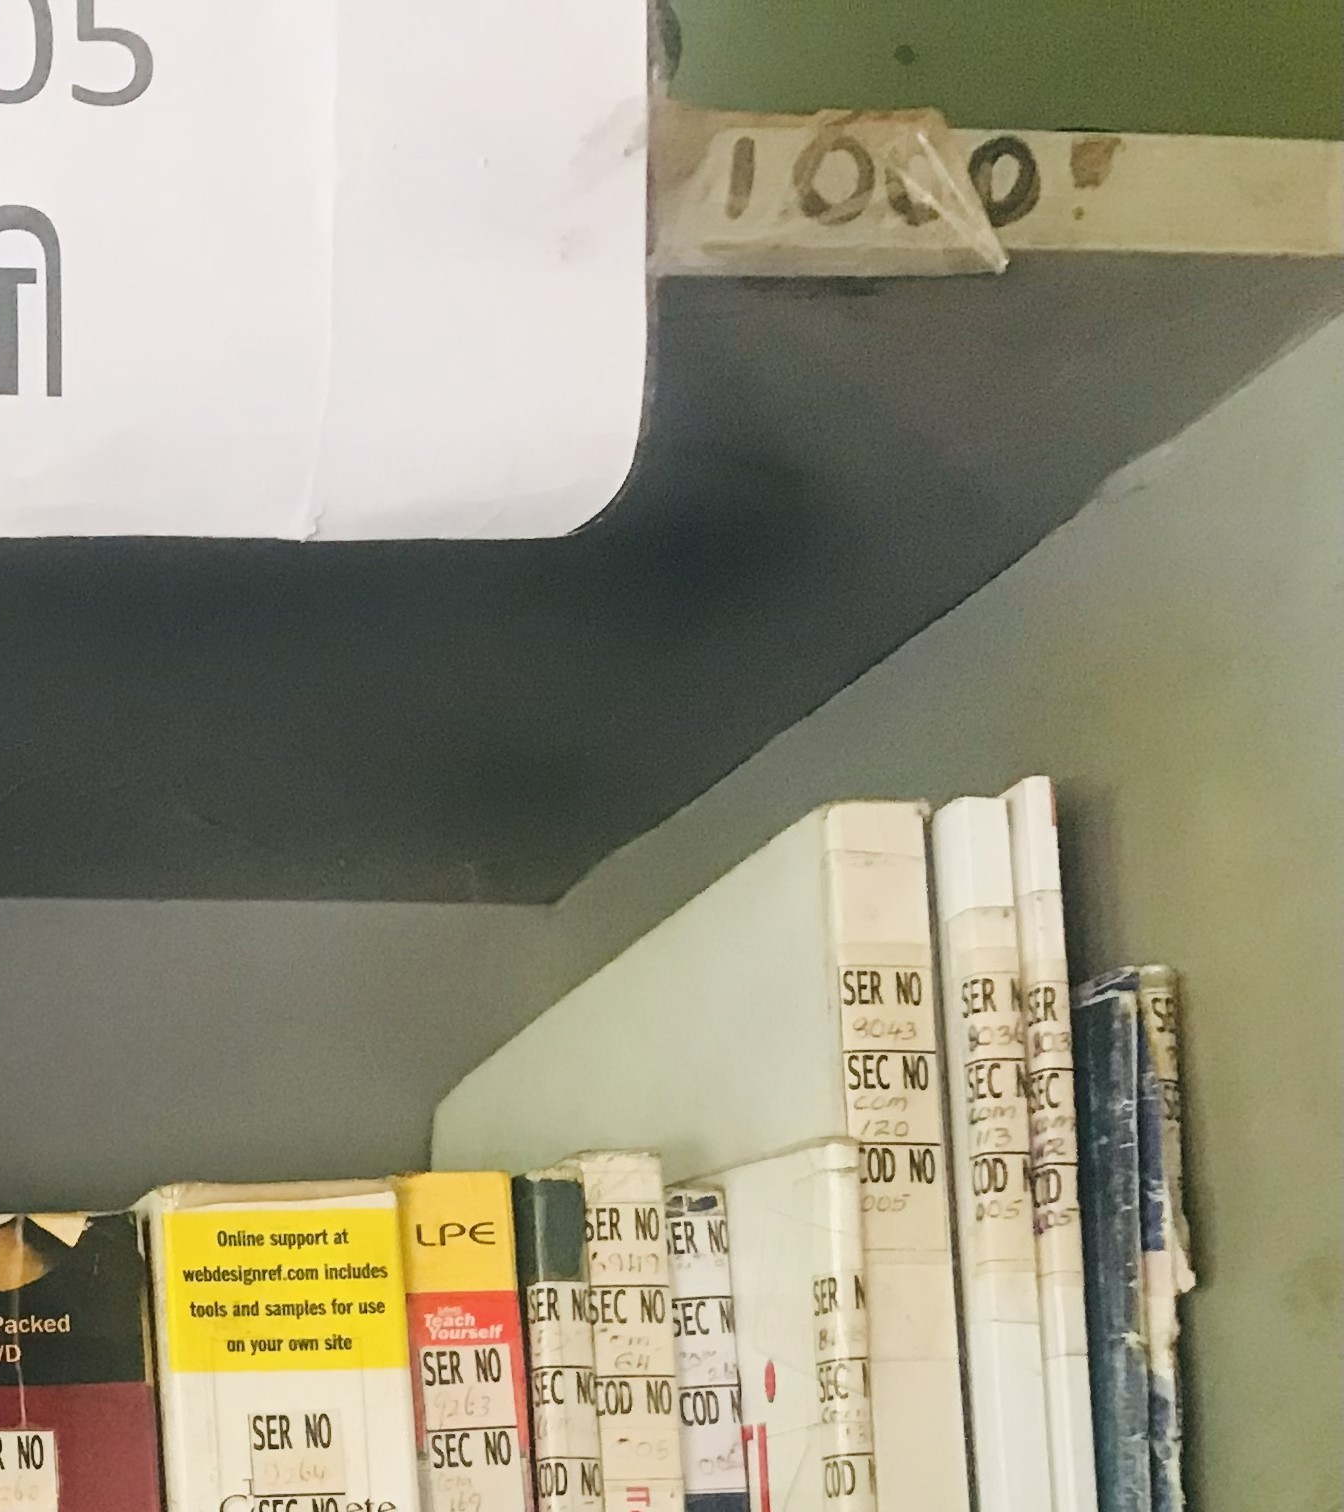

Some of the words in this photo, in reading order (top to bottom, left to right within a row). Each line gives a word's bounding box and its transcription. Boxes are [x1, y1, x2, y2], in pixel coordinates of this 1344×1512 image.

[843, 971, 882, 1005] SER
[895, 971, 922, 1005] NO
[848, 1056, 890, 1090] SEC
[903, 1056, 928, 1091] NO
[216, 1229, 264, 1248] Online
[270, 1228, 321, 1250] support
[330, 1229, 350, 1245] at
[416, 1221, 494, 1246] LPE
[182, 1262, 318, 1286] webdesignref.com
[323, 1261, 388, 1281] includes
[190, 1299, 227, 1318] tools
[232, 1299, 260, 1316] and
[264, 1299, 326, 1320] samples
[331, 1298, 353, 1315] for
[358, 1300, 386, 1315] use
[423, 1312, 477, 1330] Teach
[428, 1324, 503, 1340] Yourself
[227, 1338, 244, 1351] on
[250, 1336, 283, 1355] your
[288, 1336, 320, 1351] own
[324, 1332, 352, 1350] site
